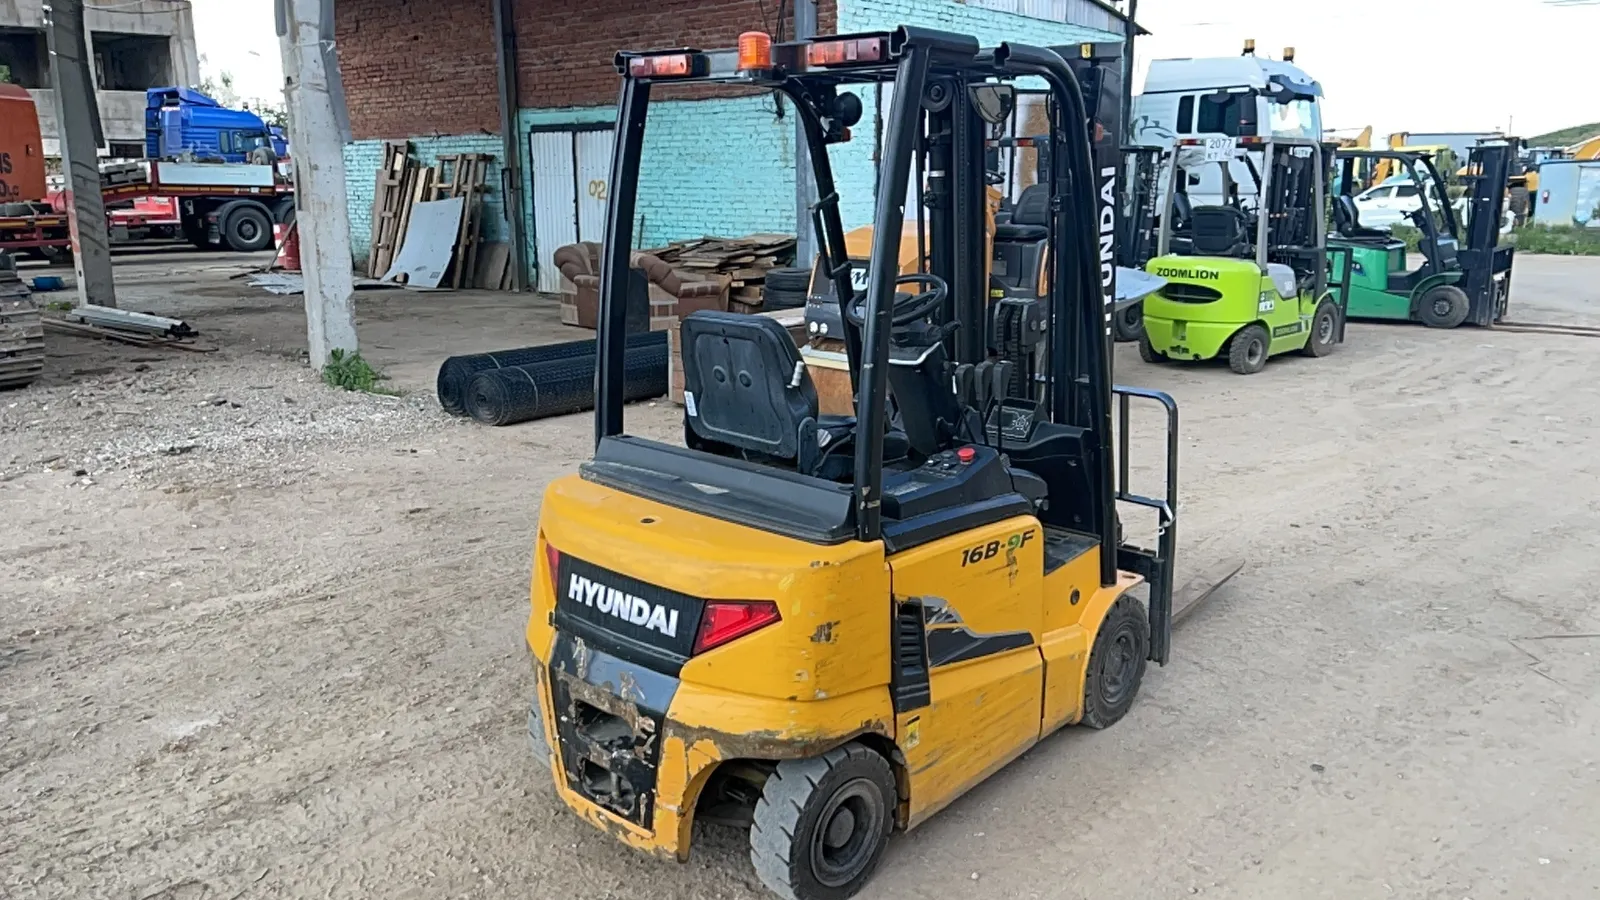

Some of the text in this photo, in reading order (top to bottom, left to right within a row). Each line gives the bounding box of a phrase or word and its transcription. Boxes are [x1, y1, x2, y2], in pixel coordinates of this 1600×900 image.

[1209, 138, 1232, 149] 2077
[589, 180, 607, 199] 02
[1156, 267, 1219, 280] ZOOMLION
[961, 529, 1035, 568] 16B-9F
[568, 572, 679, 638] HYUNDAI
